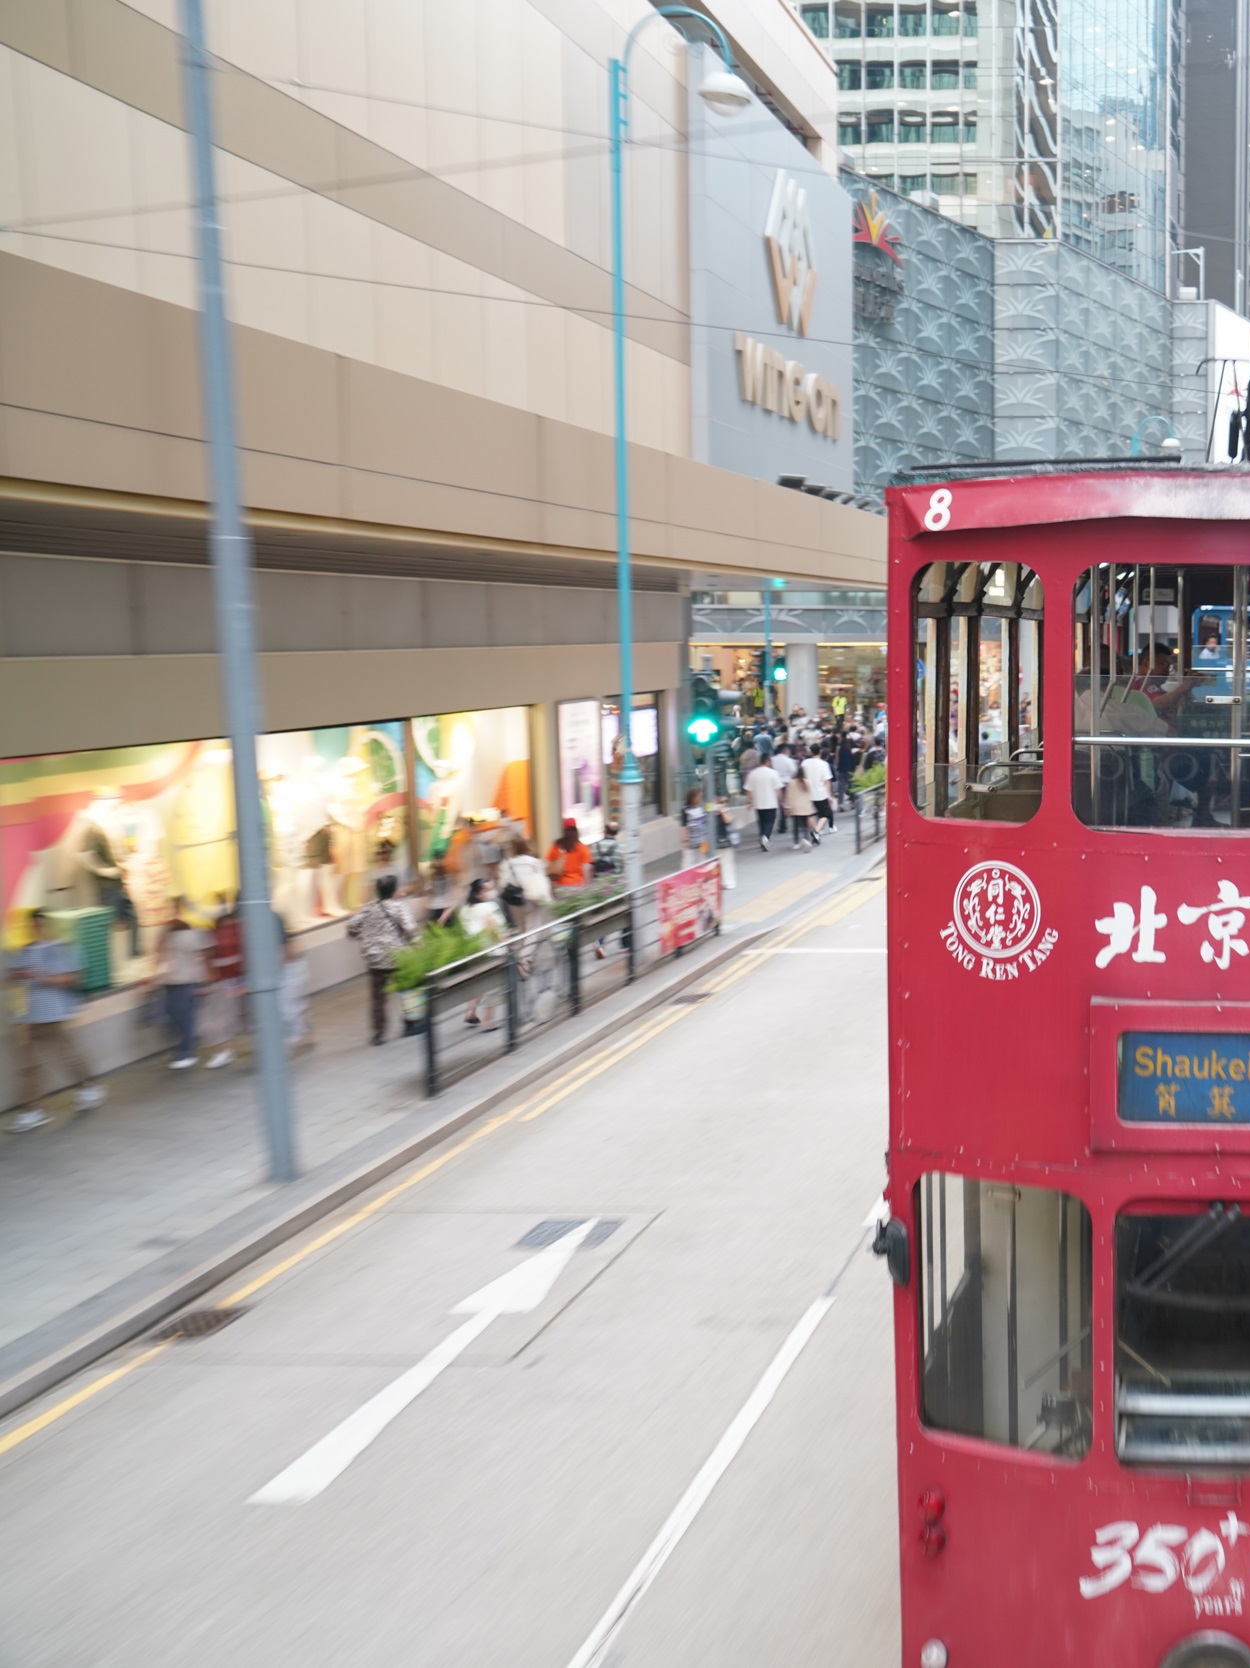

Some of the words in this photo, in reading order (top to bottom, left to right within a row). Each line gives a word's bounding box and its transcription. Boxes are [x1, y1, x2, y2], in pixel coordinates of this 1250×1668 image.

[924, 488, 953, 532] 8
[940, 920, 976, 970] TONG
[979, 957, 1019, 981] REN
[1018, 927, 1059, 973] TANG
